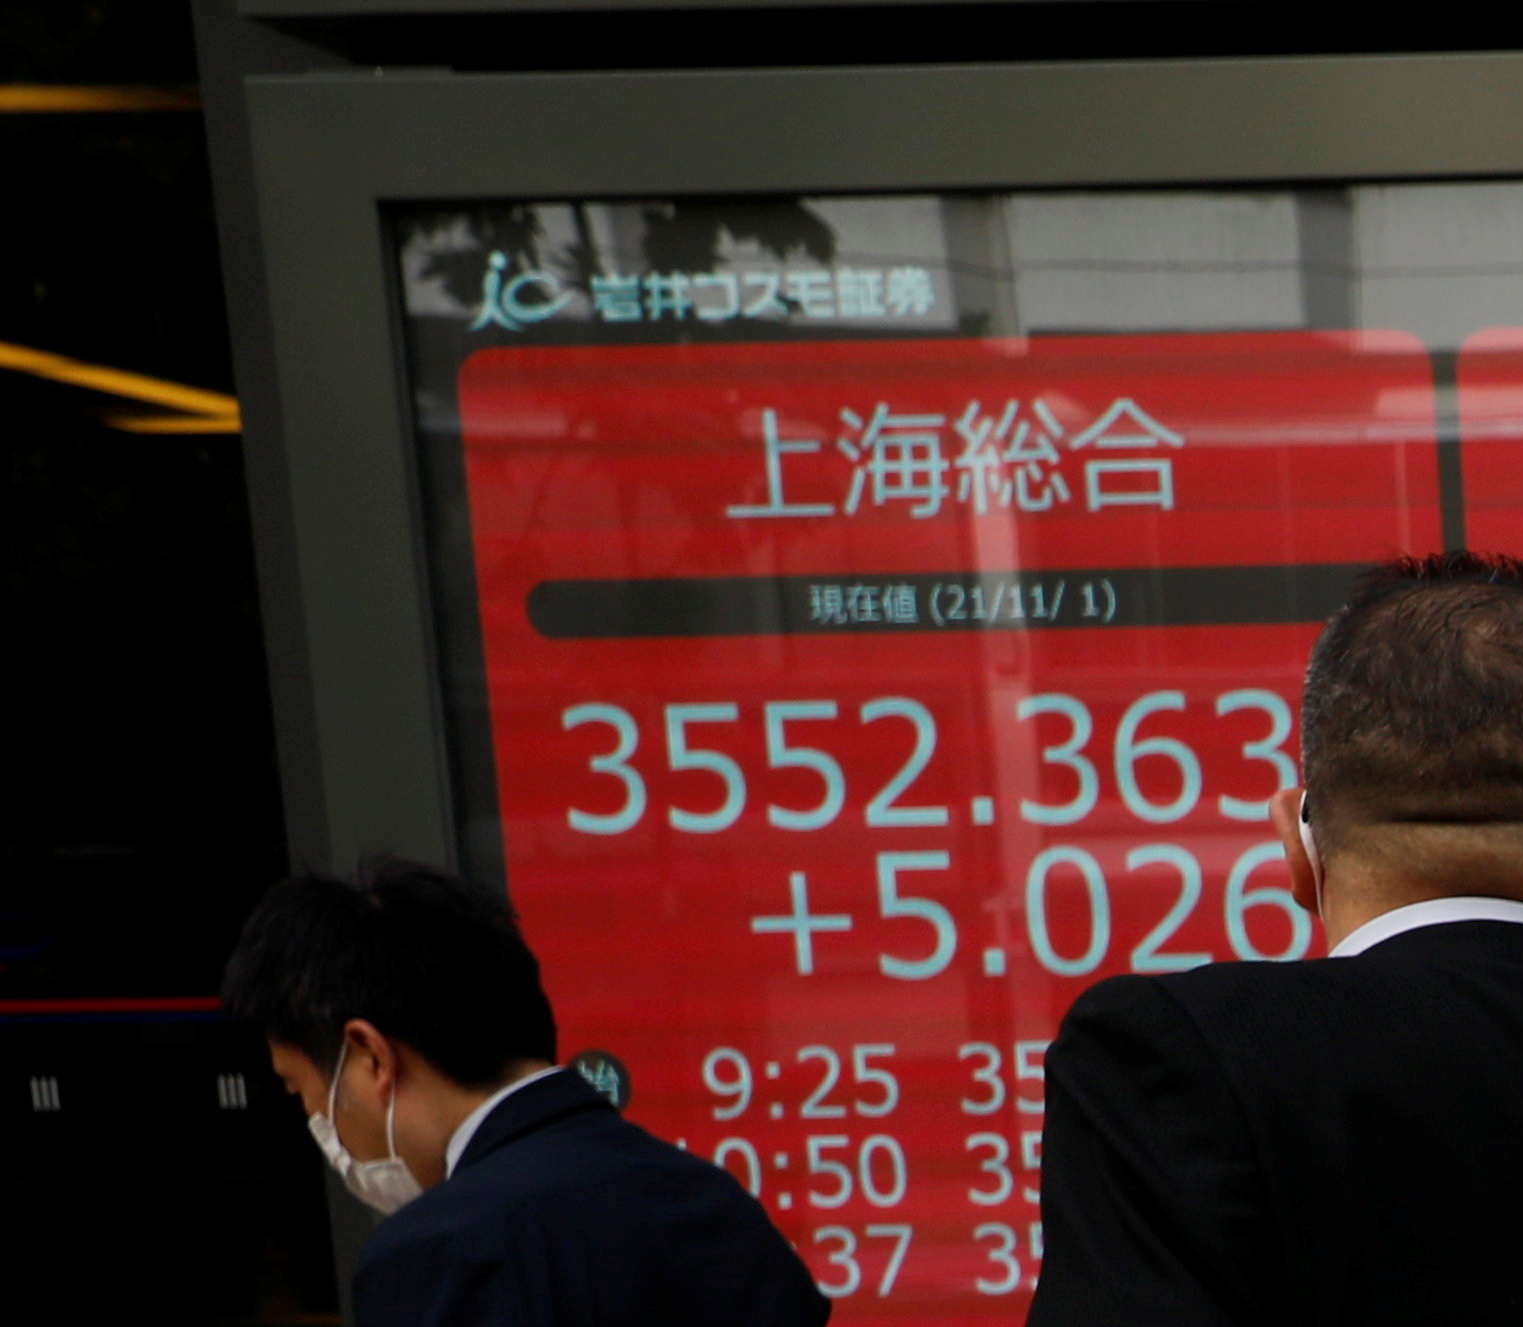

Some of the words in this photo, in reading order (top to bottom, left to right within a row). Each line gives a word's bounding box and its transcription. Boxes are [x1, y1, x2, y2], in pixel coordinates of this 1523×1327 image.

[592, 268, 935, 322] 岩井コスモ証券
[731, 401, 1181, 515] 上海総合
[811, 584, 919, 624] 現在値
[561, 690, 1298, 834] 3552.363
[754, 843, 1310, 977] +5.026
[705, 1046, 896, 1117] 9:25
[677, 1134, 908, 1210] 0:50
